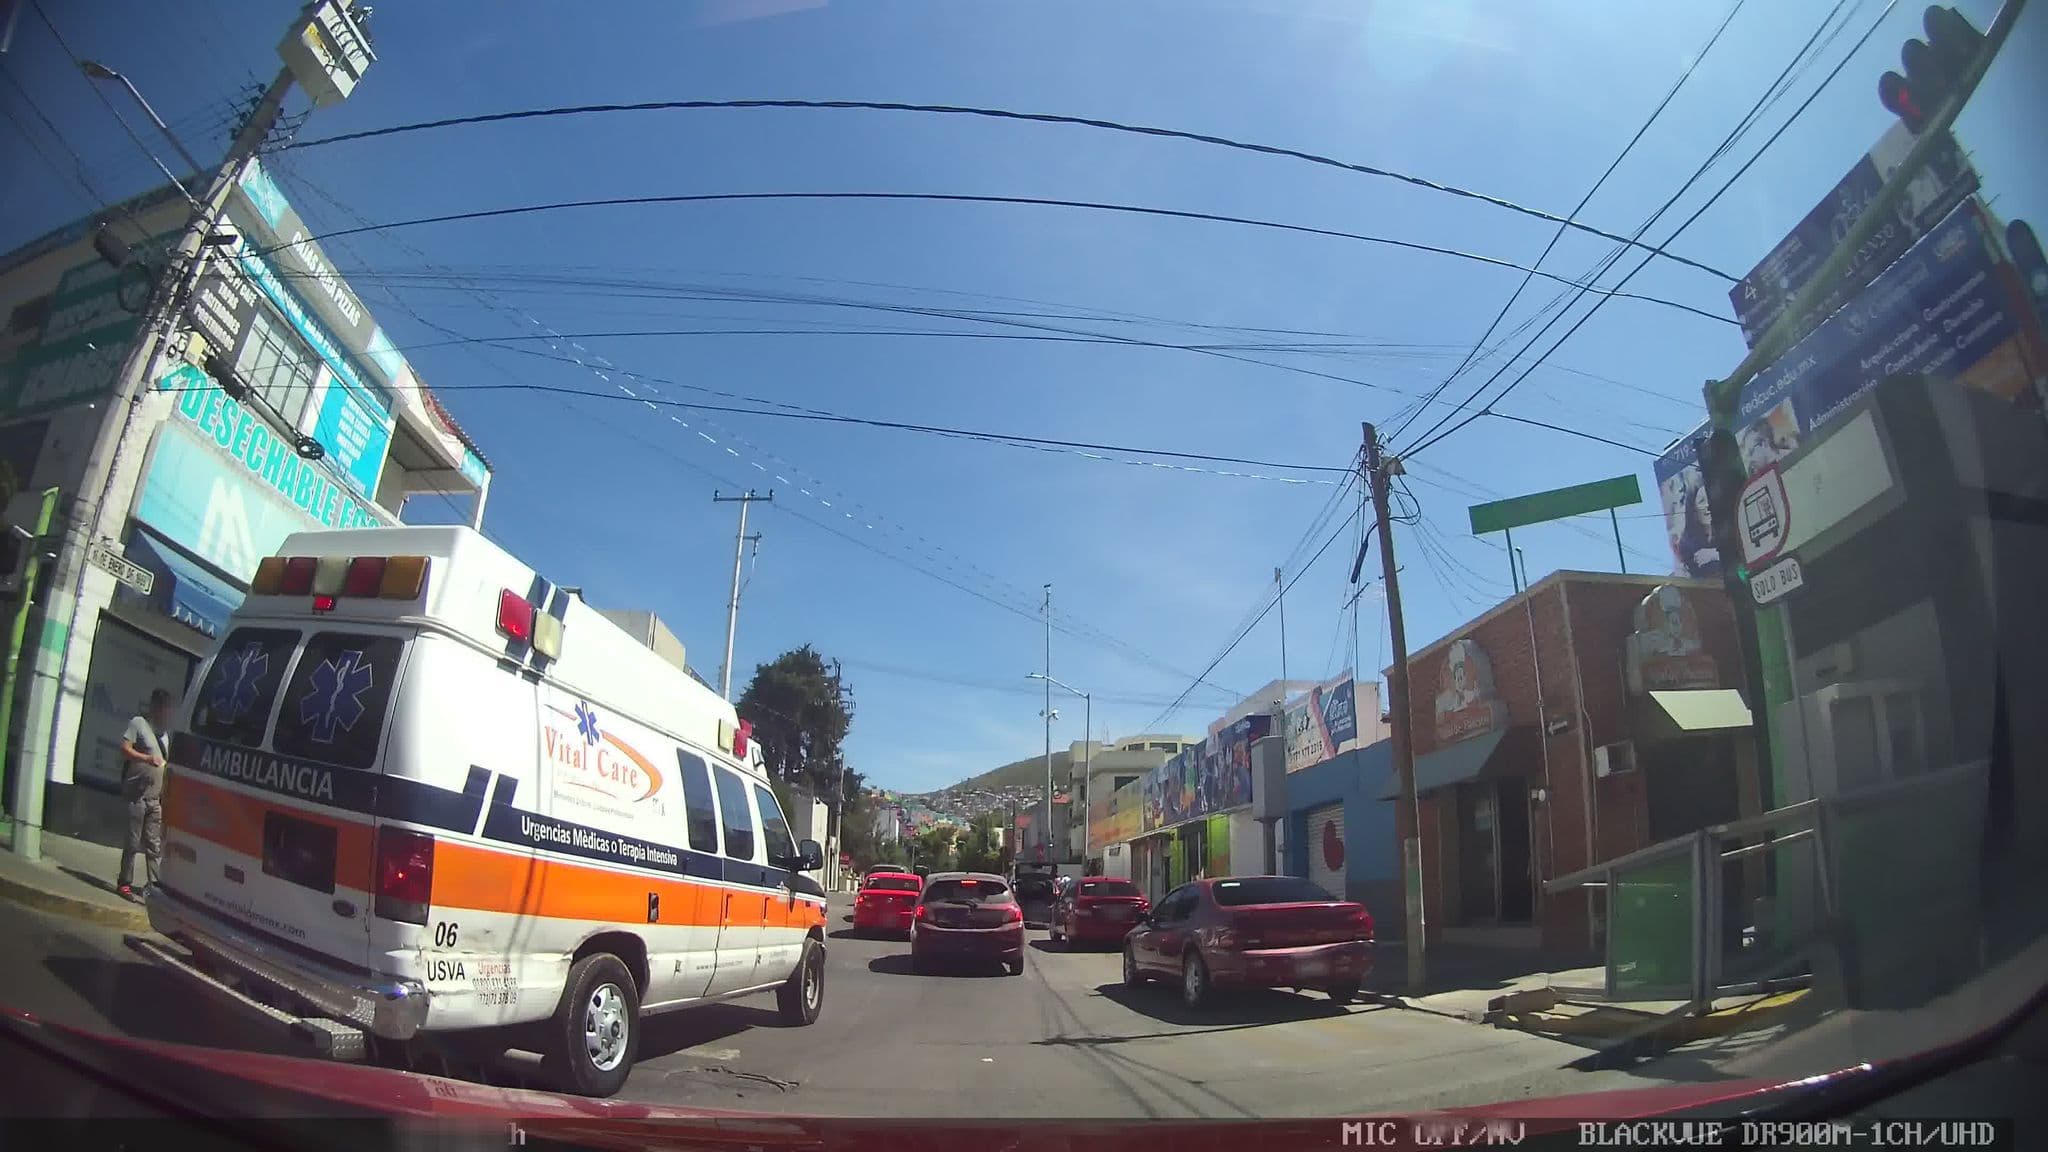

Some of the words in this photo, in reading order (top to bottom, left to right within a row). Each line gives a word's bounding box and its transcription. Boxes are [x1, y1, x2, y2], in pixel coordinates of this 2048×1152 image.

[334, 288, 361, 328] PIZZAS
[179, 366, 341, 528] DESECHABLE
[1754, 574, 1777, 599] SOLO
[1780, 562, 1799, 586] BUS
[200, 743, 334, 800] AMBULANCIA
[544, 725, 588, 771] Vital
[597, 749, 640, 789] Care
[521, 815, 571, 842] Urgencias
[610, 841, 618, 853] o
[617, 837, 646, 863] Terapia
[646, 845, 678, 866] Intensiva
[434, 921, 459, 947] 06
[427, 960, 466, 982] USVA
[478, 961, 511, 978] Urgencias
